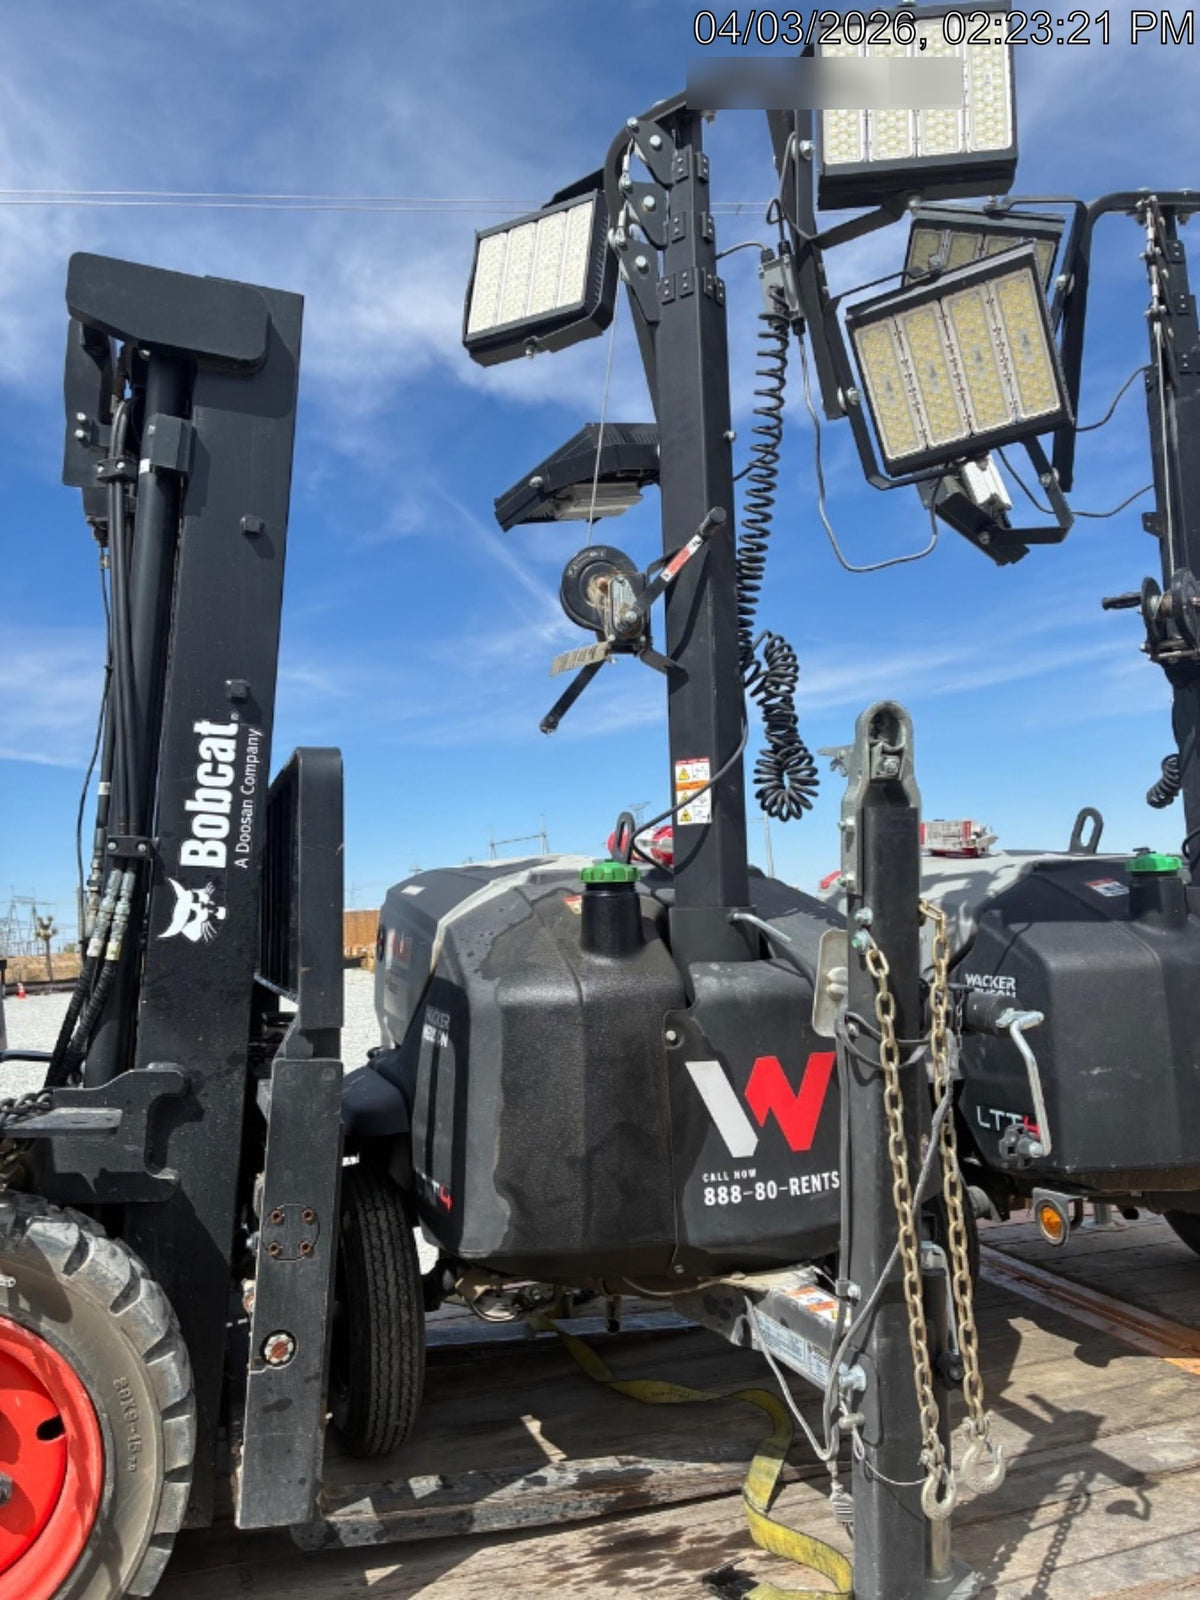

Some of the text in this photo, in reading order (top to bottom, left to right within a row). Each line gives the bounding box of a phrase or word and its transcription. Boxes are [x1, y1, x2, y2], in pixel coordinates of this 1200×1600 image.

[179, 720, 239, 868] Bobcat
[234, 728, 263, 869] A Doosan Company
[965, 972, 1016, 991] WACKER
[702, 1168, 757, 1182] CALL NOW
[703, 1170, 841, 1206] 888-80-RENTS
